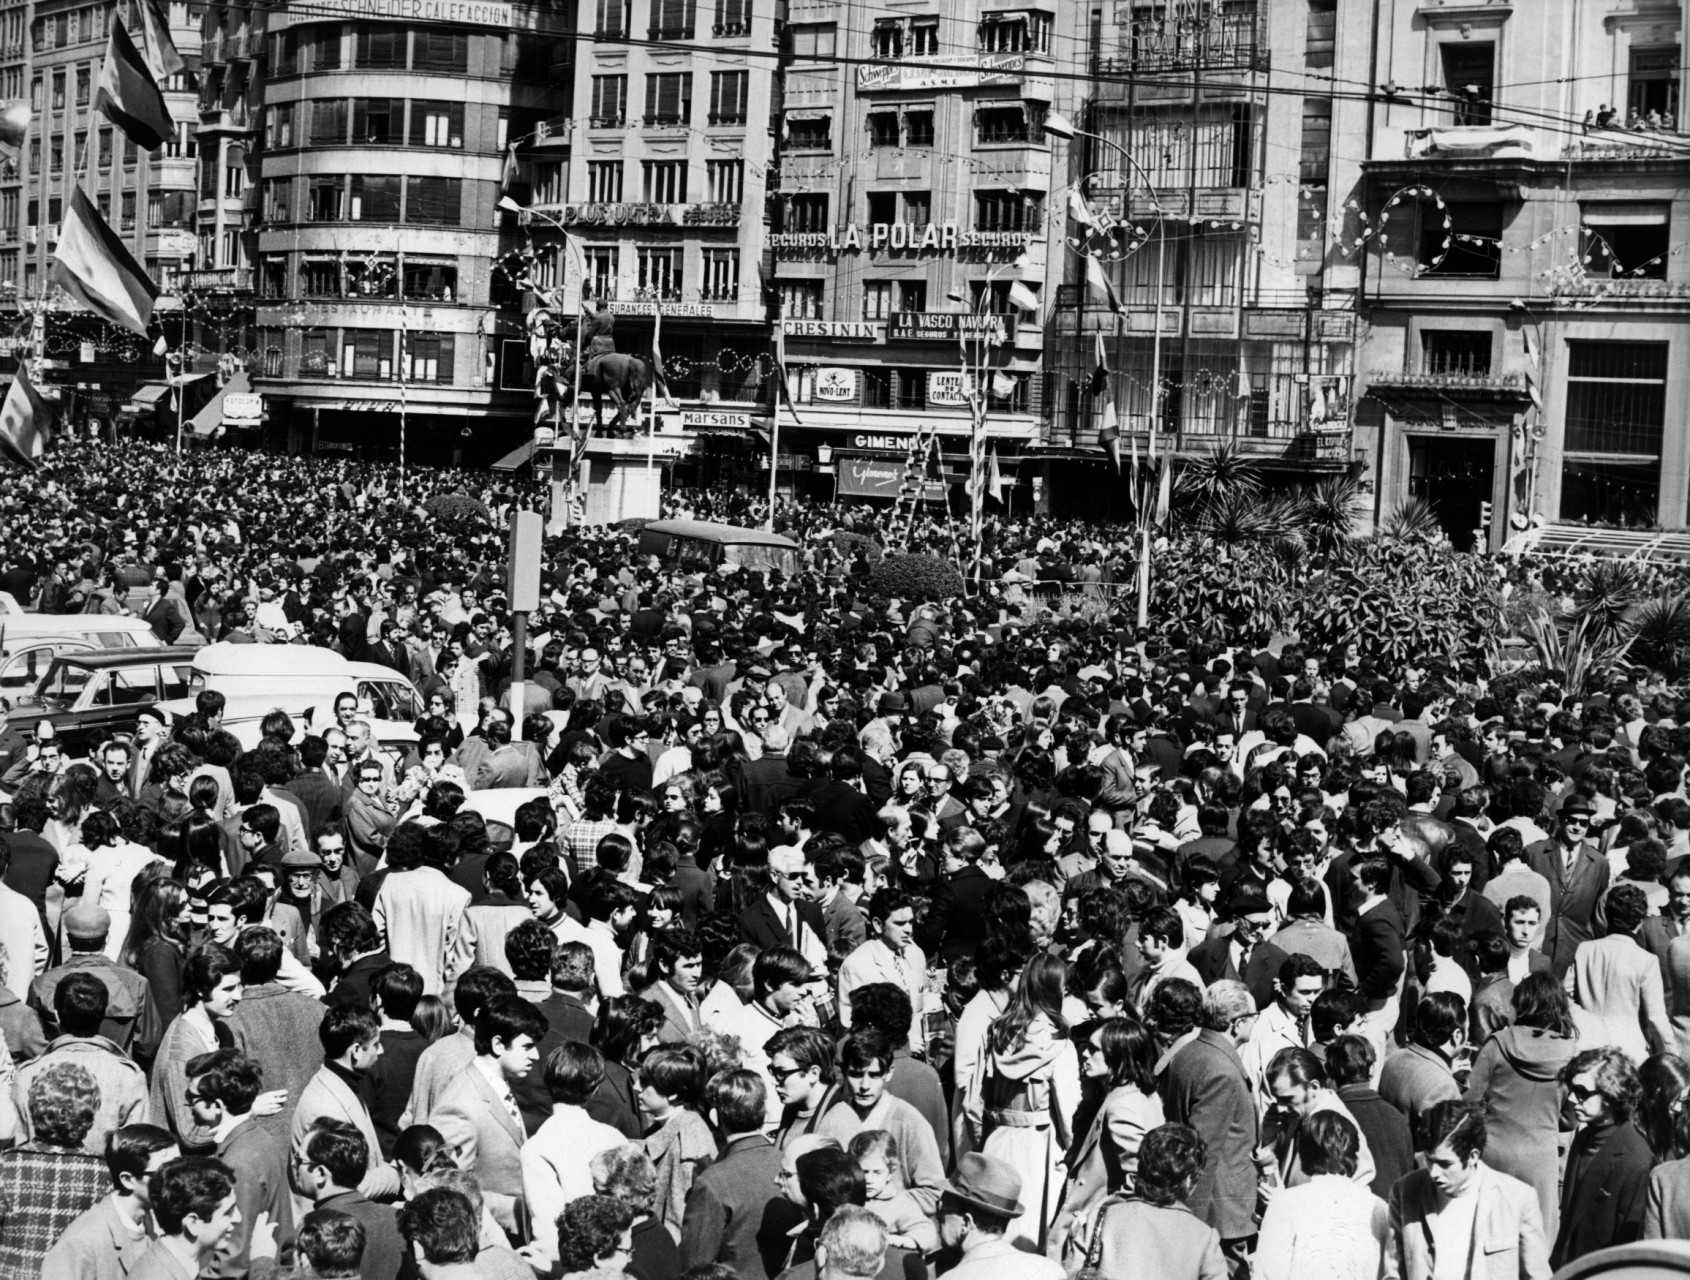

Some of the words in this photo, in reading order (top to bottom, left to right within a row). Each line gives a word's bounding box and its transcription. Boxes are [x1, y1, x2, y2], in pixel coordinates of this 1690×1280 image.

[425, 3, 508, 25] CALEFACCION
[765, 232, 827, 247] SEGUROS
[829, 223, 861, 249] LA
[872, 222, 958, 250] POLAR
[960, 231, 1031, 247] SEGUROS
[899, 314, 912, 327] LA
[919, 315, 952, 328] VASCO
[783, 322, 874, 337] CRESININ
[937, 376, 959, 386] LENTE
[932, 391, 963, 401] CONTACT
[684, 413, 746, 426] Marsans
